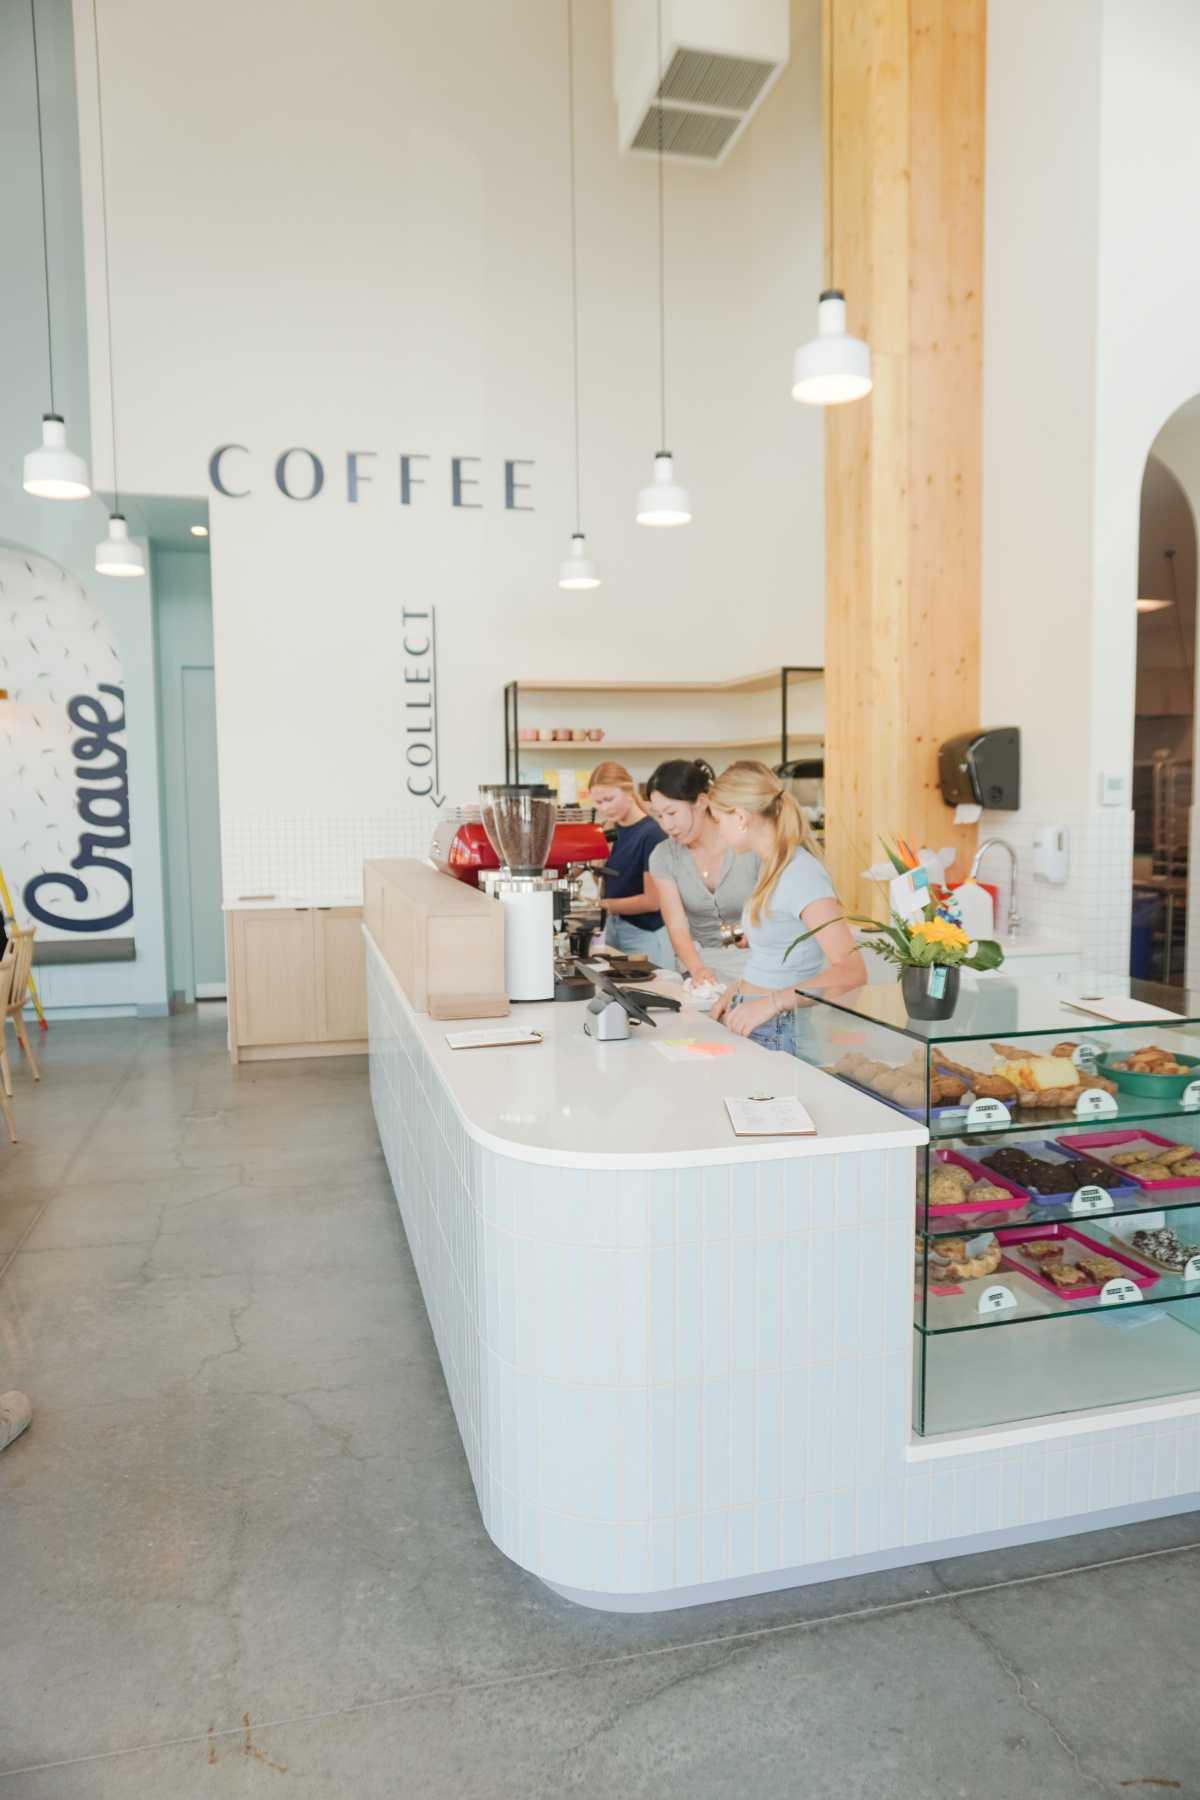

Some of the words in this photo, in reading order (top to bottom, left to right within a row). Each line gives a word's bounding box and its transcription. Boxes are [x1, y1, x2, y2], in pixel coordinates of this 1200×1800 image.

[208, 443, 535, 511] COFFEE
[402, 605, 434, 796] COLLECT
[23, 683, 134, 932] Crave
